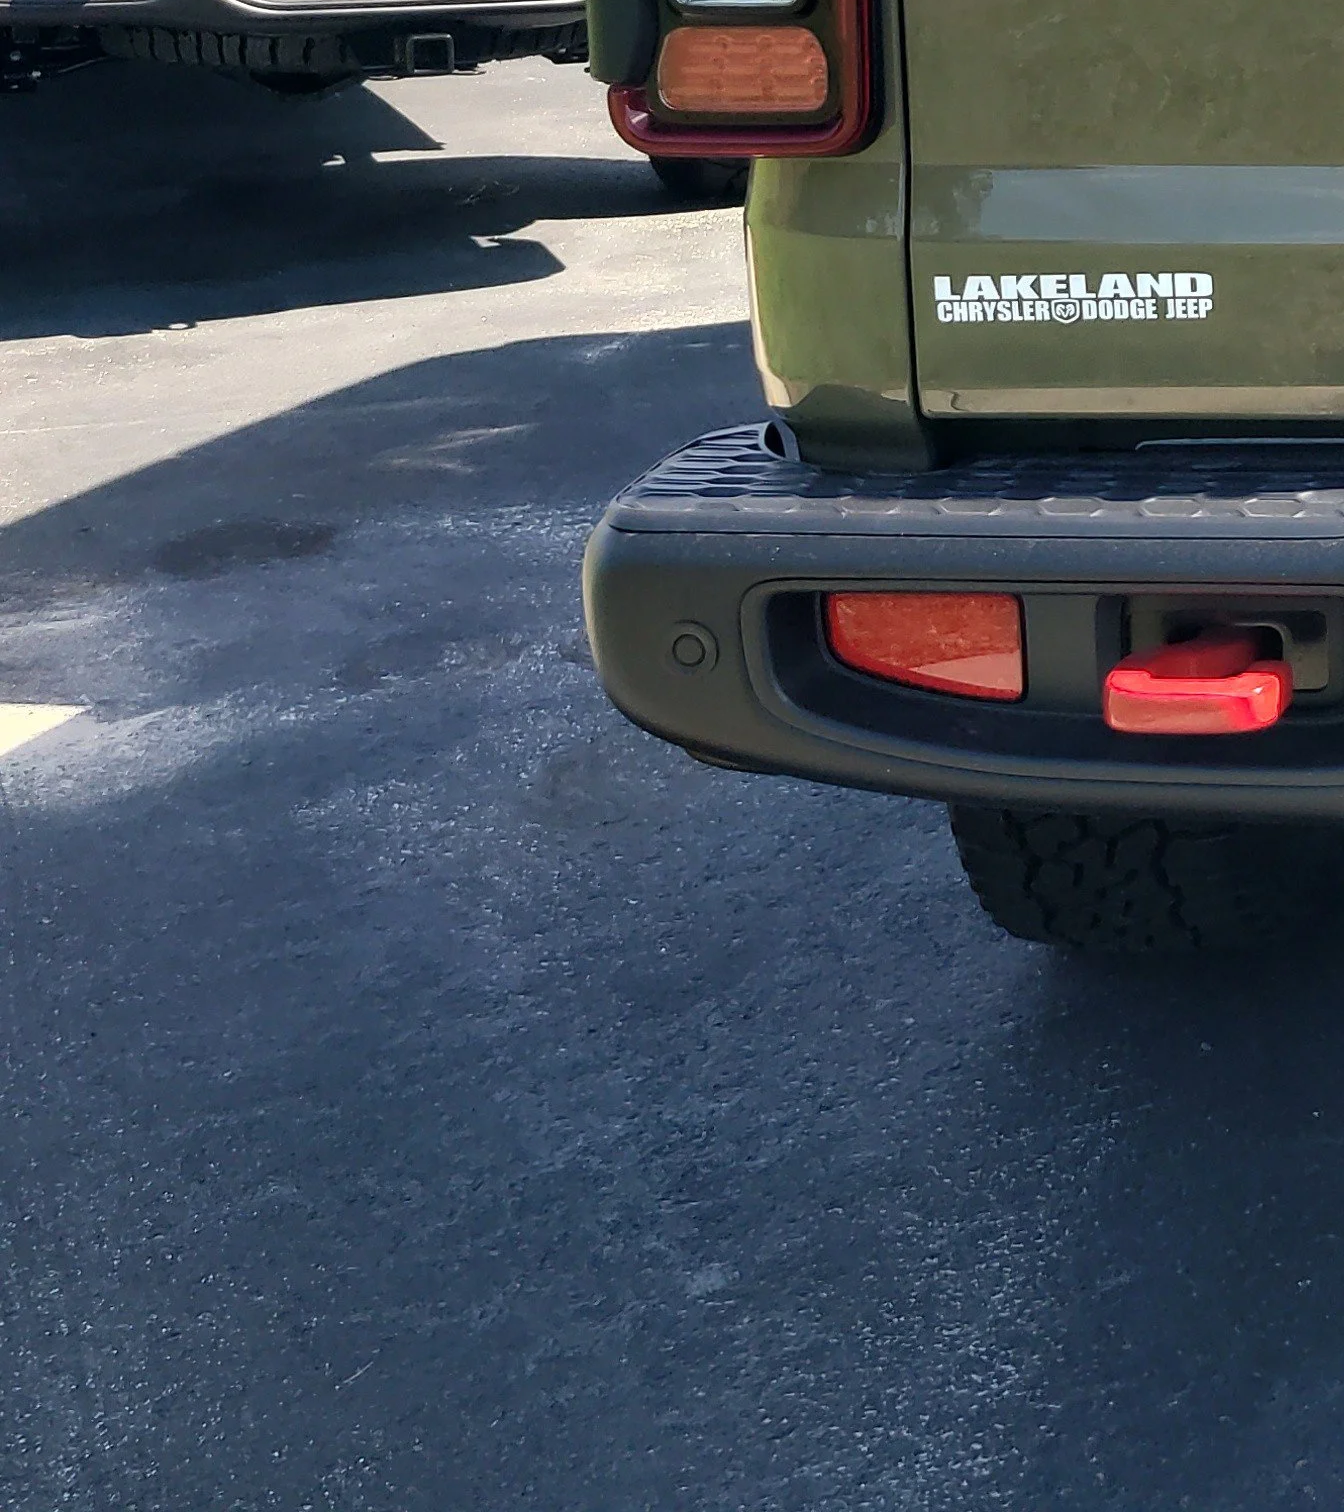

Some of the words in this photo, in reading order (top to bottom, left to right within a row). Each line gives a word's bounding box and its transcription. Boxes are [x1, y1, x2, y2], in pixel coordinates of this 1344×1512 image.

[934, 273, 1214, 300] LAKELAND
[937, 300, 1050, 322] CHRYSLER
[1081, 299, 1158, 319] DODGE
[1166, 298, 1213, 319] JEEP
